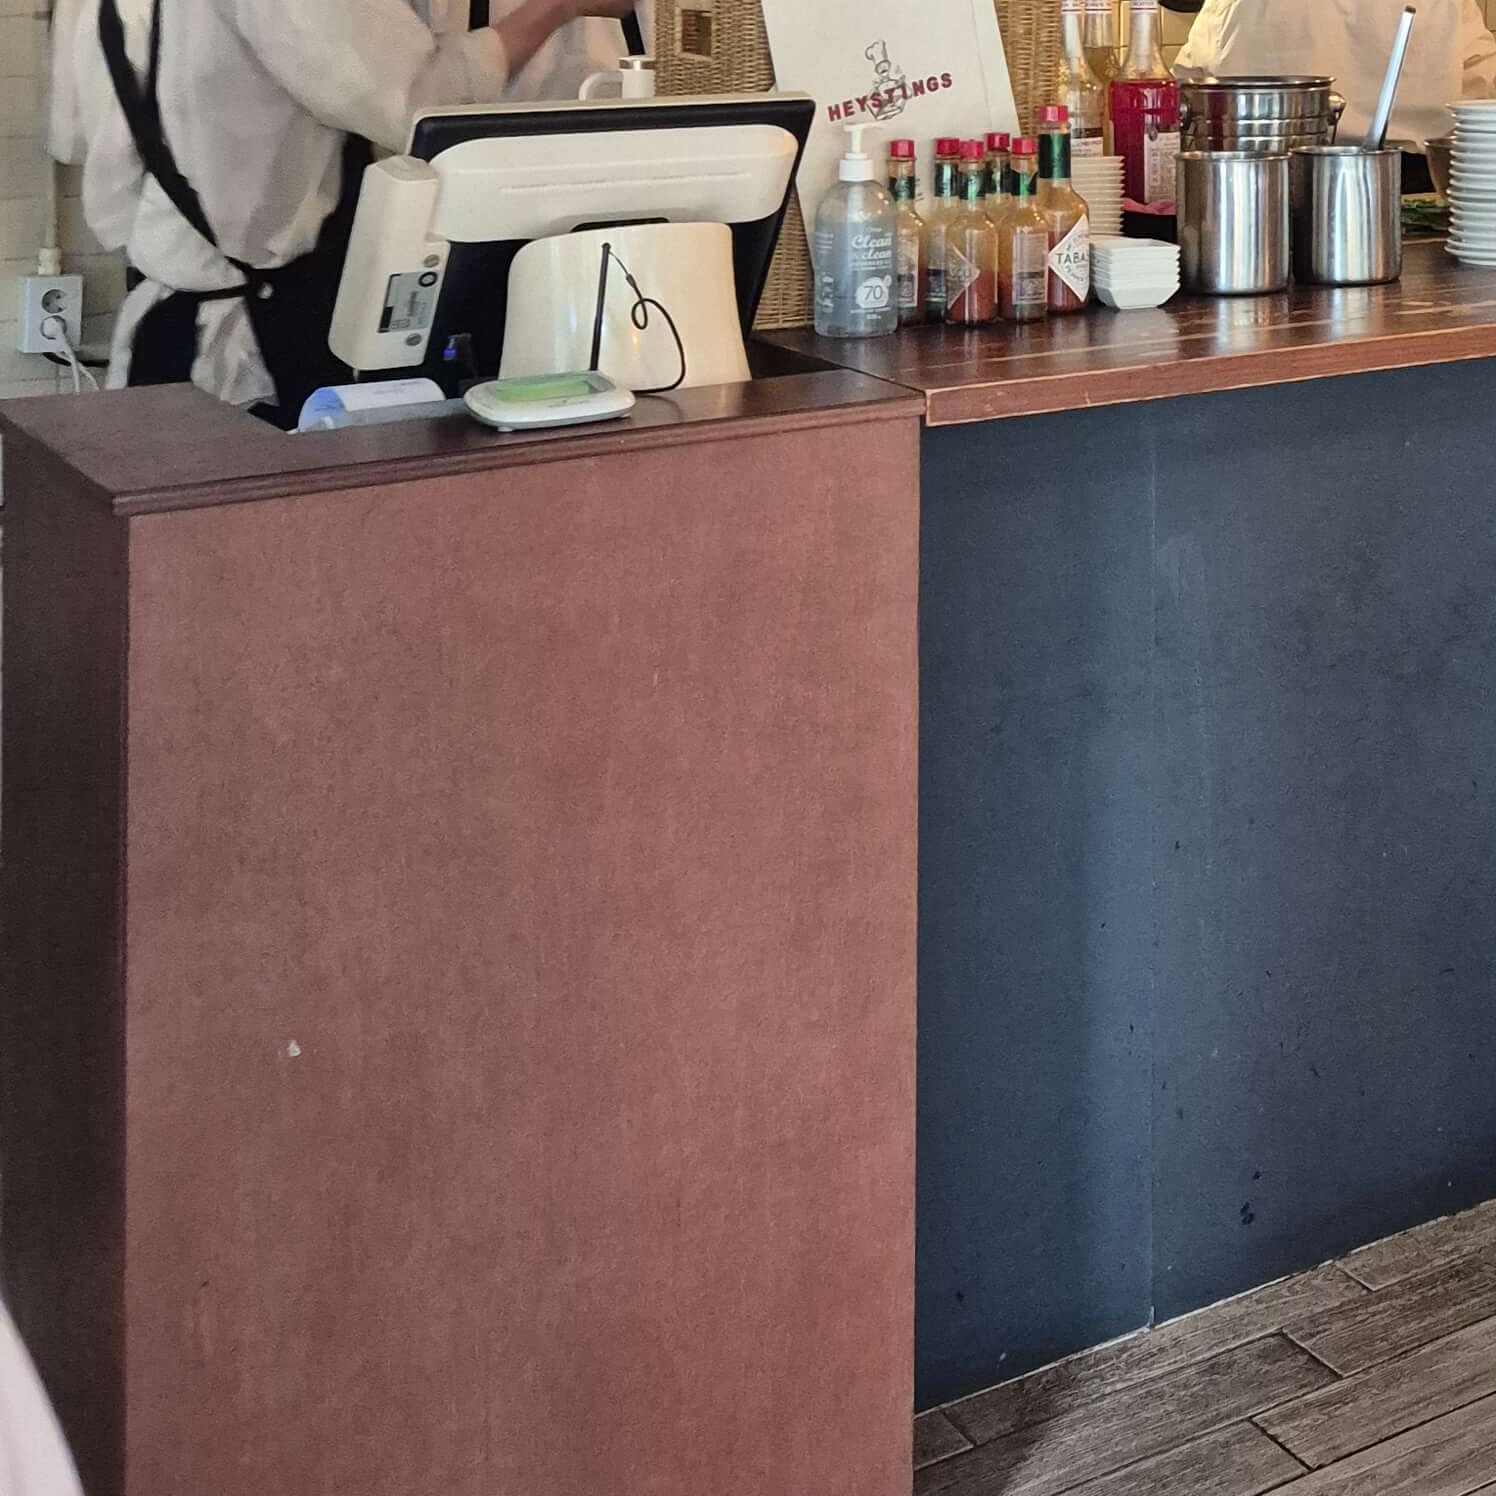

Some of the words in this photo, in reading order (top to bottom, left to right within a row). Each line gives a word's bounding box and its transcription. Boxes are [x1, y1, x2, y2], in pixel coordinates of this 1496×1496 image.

[827, 72, 952, 122] HEYSTINGS
[851, 234, 892, 249] Clean
[1055, 251, 1089, 264] TABA
[863, 285, 883, 301] 70
